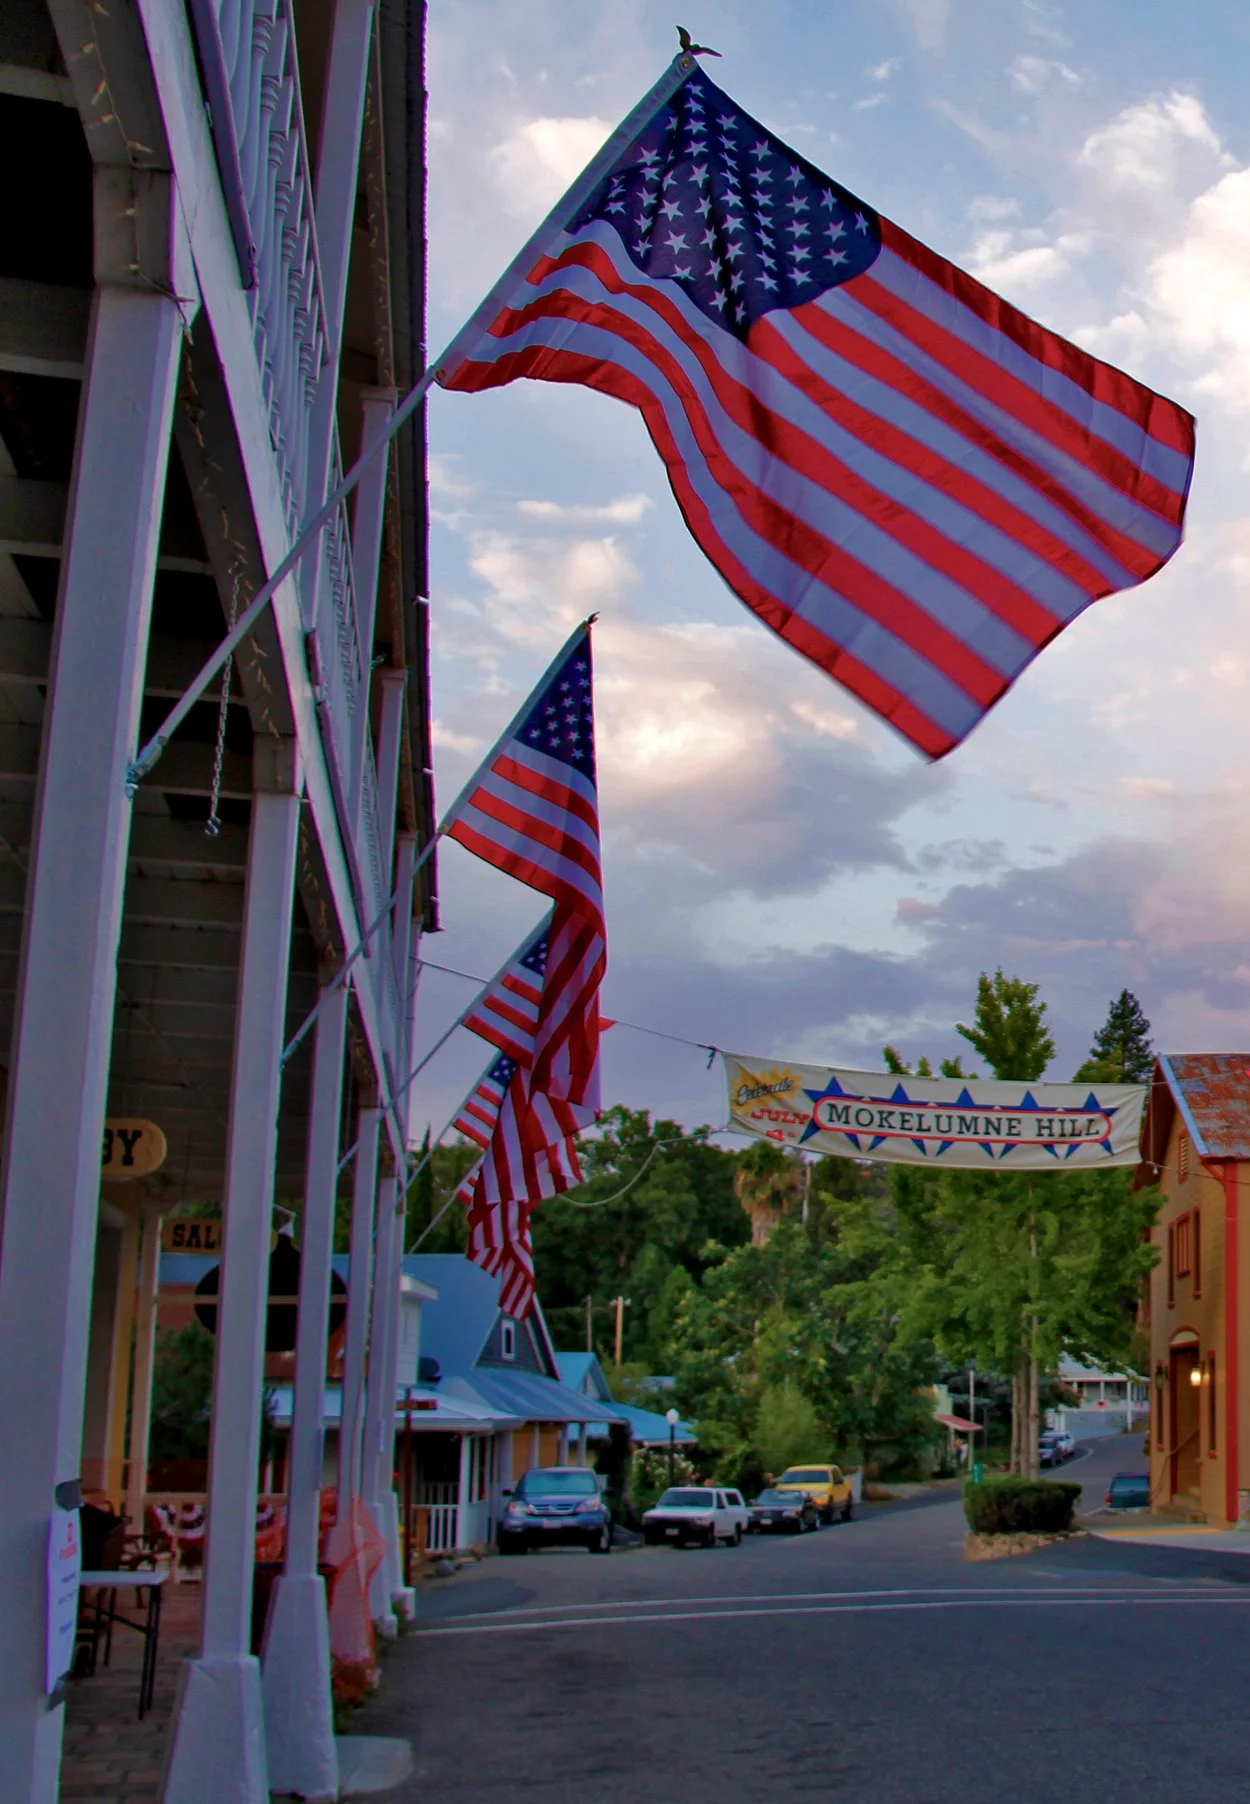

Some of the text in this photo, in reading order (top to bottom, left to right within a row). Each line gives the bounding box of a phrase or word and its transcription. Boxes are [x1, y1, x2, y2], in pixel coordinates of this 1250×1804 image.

[751, 1108, 811, 1125] JULY
[827, 1103, 1101, 1138] MOKELUMNE HILL
[172, 1223, 221, 1249] SAL
